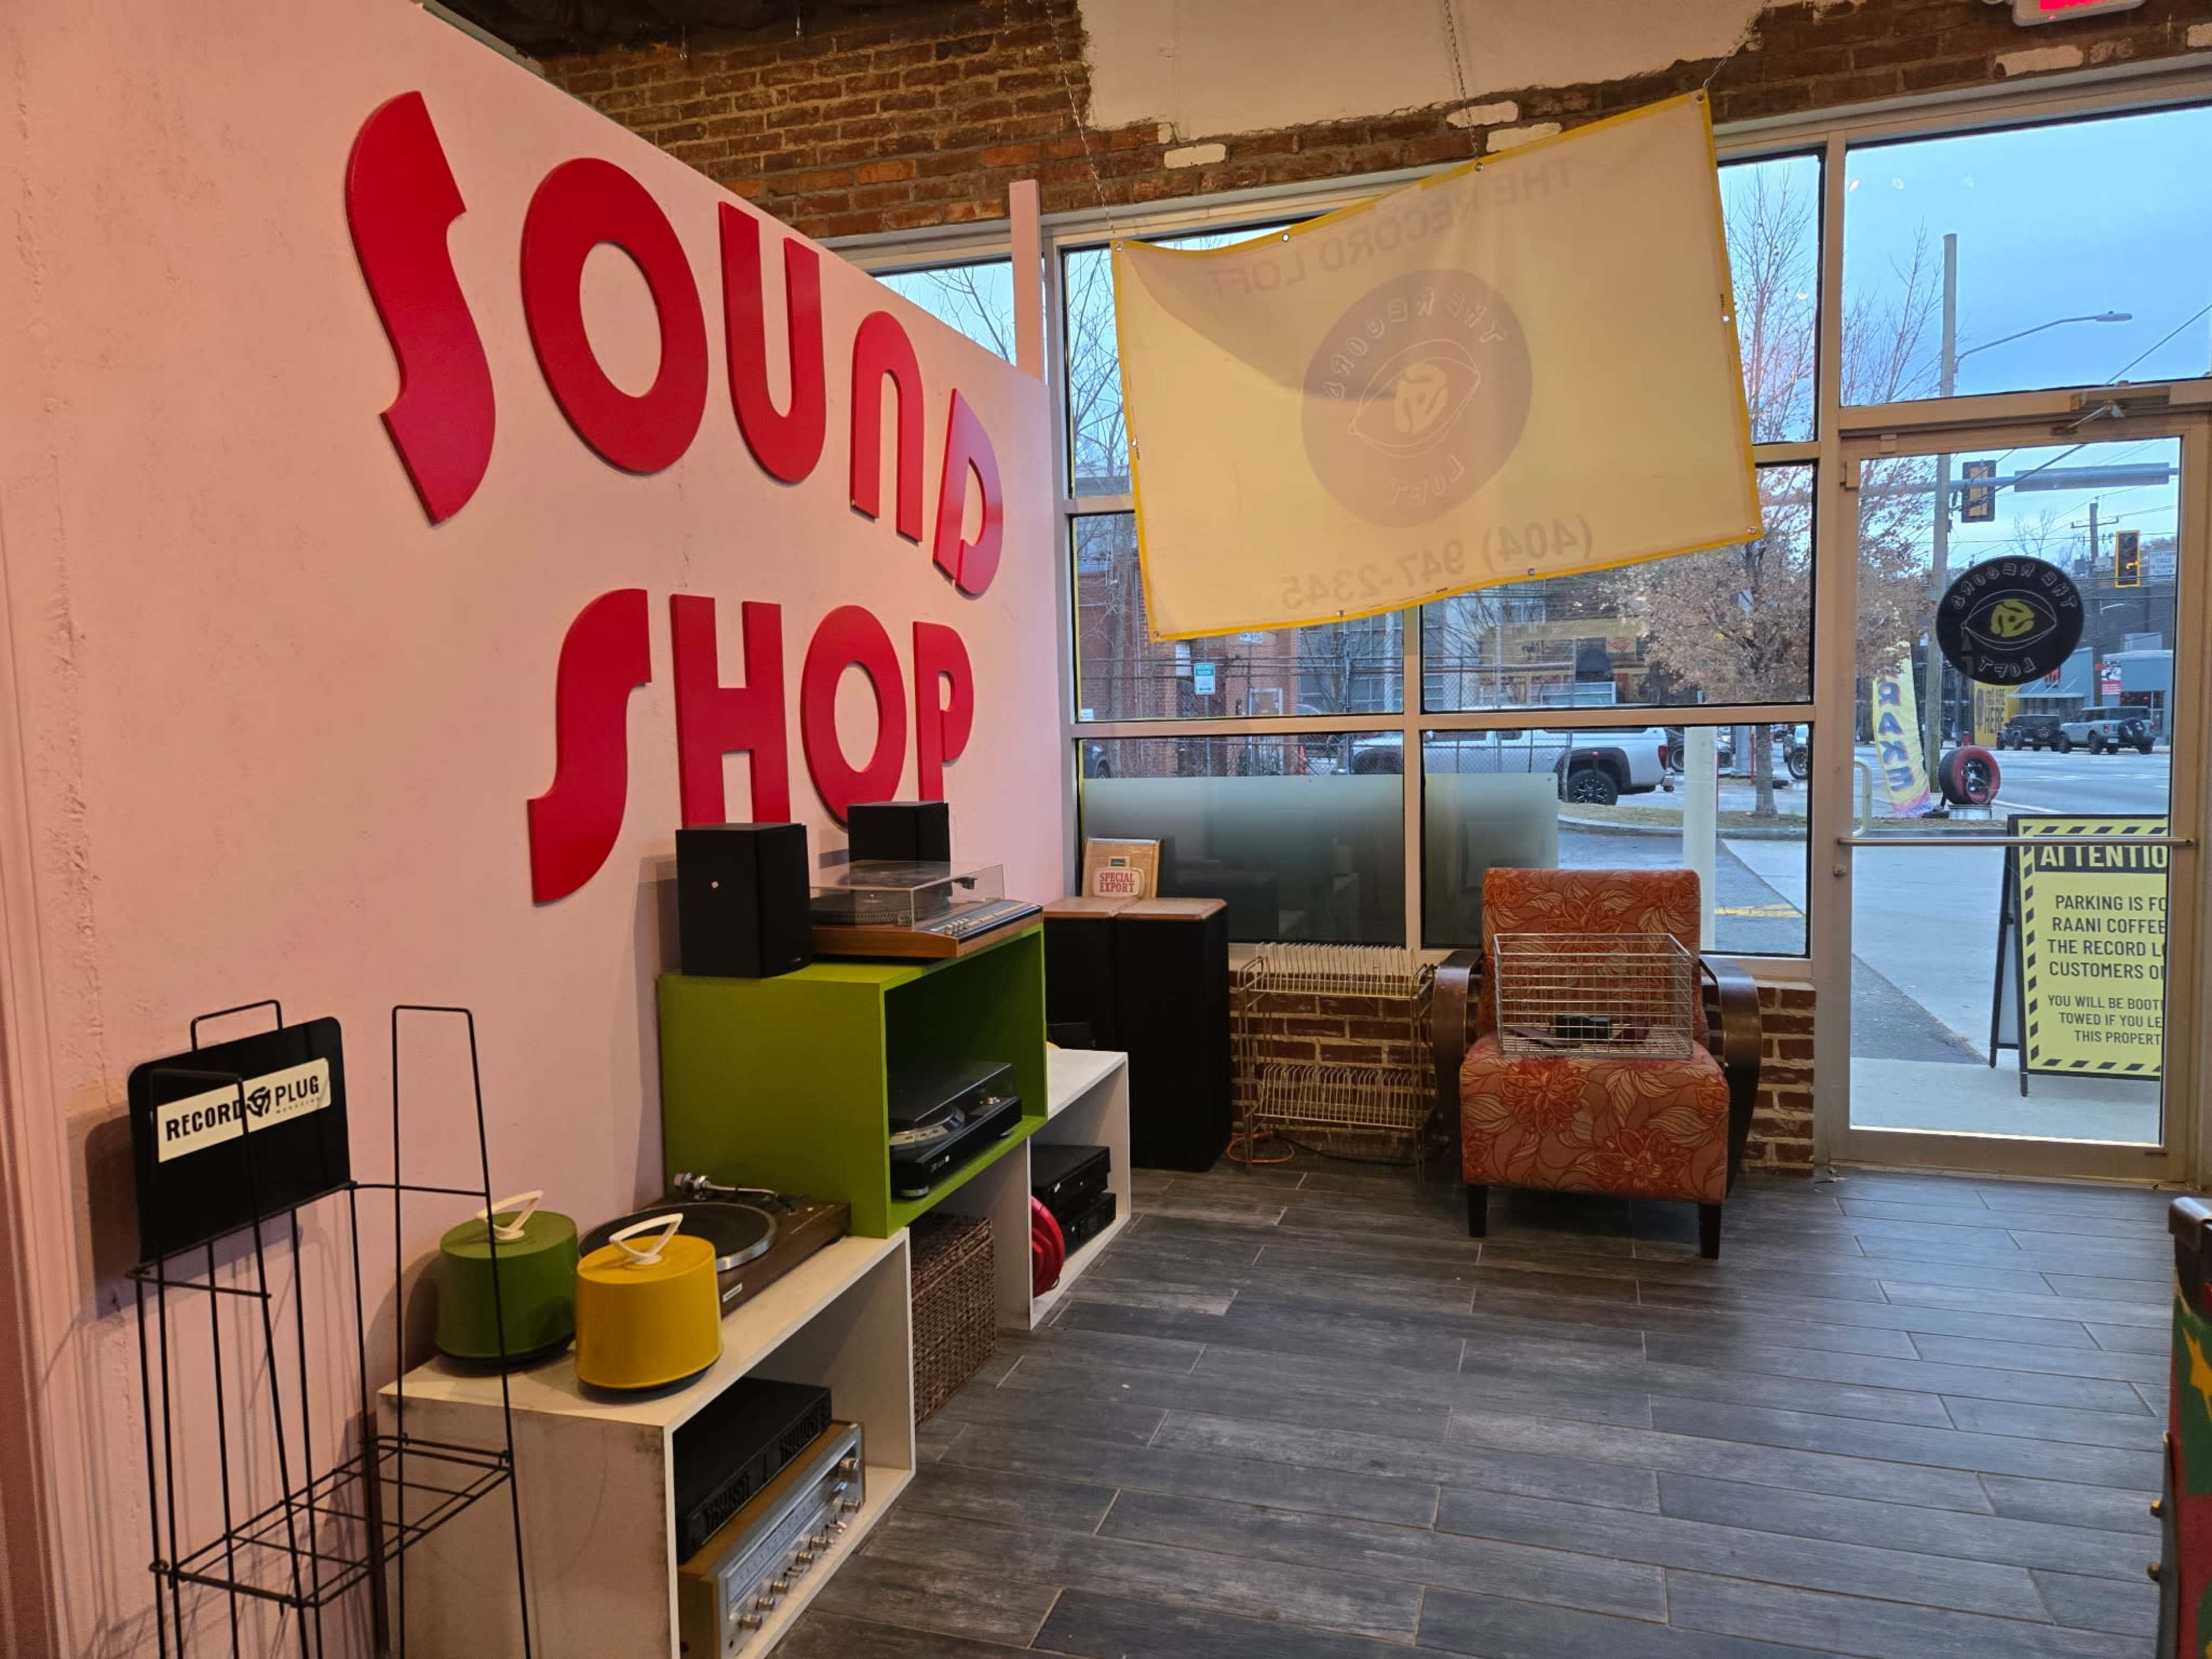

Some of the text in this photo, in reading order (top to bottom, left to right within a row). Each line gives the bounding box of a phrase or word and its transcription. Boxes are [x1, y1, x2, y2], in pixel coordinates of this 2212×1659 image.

[345, 90, 1003, 597] SOUND
[527, 589, 973, 906] SHOP
[1100, 872, 1135, 882] SPECIAL
[1100, 882, 1134, 892] EXPORT
[2056, 895, 2123, 910] PARKING
[2129, 896, 2143, 911] IS
[2052, 917, 2165, 934] RAANI COFFEE
[2047, 939, 2078, 954] THE
[2083, 940, 2146, 956] RECORD
[2050, 961, 2143, 979] CUSTOMERS
[2048, 995, 2071, 1006] YOU
[2075, 996, 2105, 1008] WILL
[2109, 998, 2123, 1009] BE
[2059, 1012, 2101, 1025] TOWED
[2105, 1014, 2115, 1025] IF
[2120, 1015, 2143, 1027] YOU
[2074, 1030, 2101, 1042] THIS
[166, 1075, 319, 1141] RECORD PLUG
